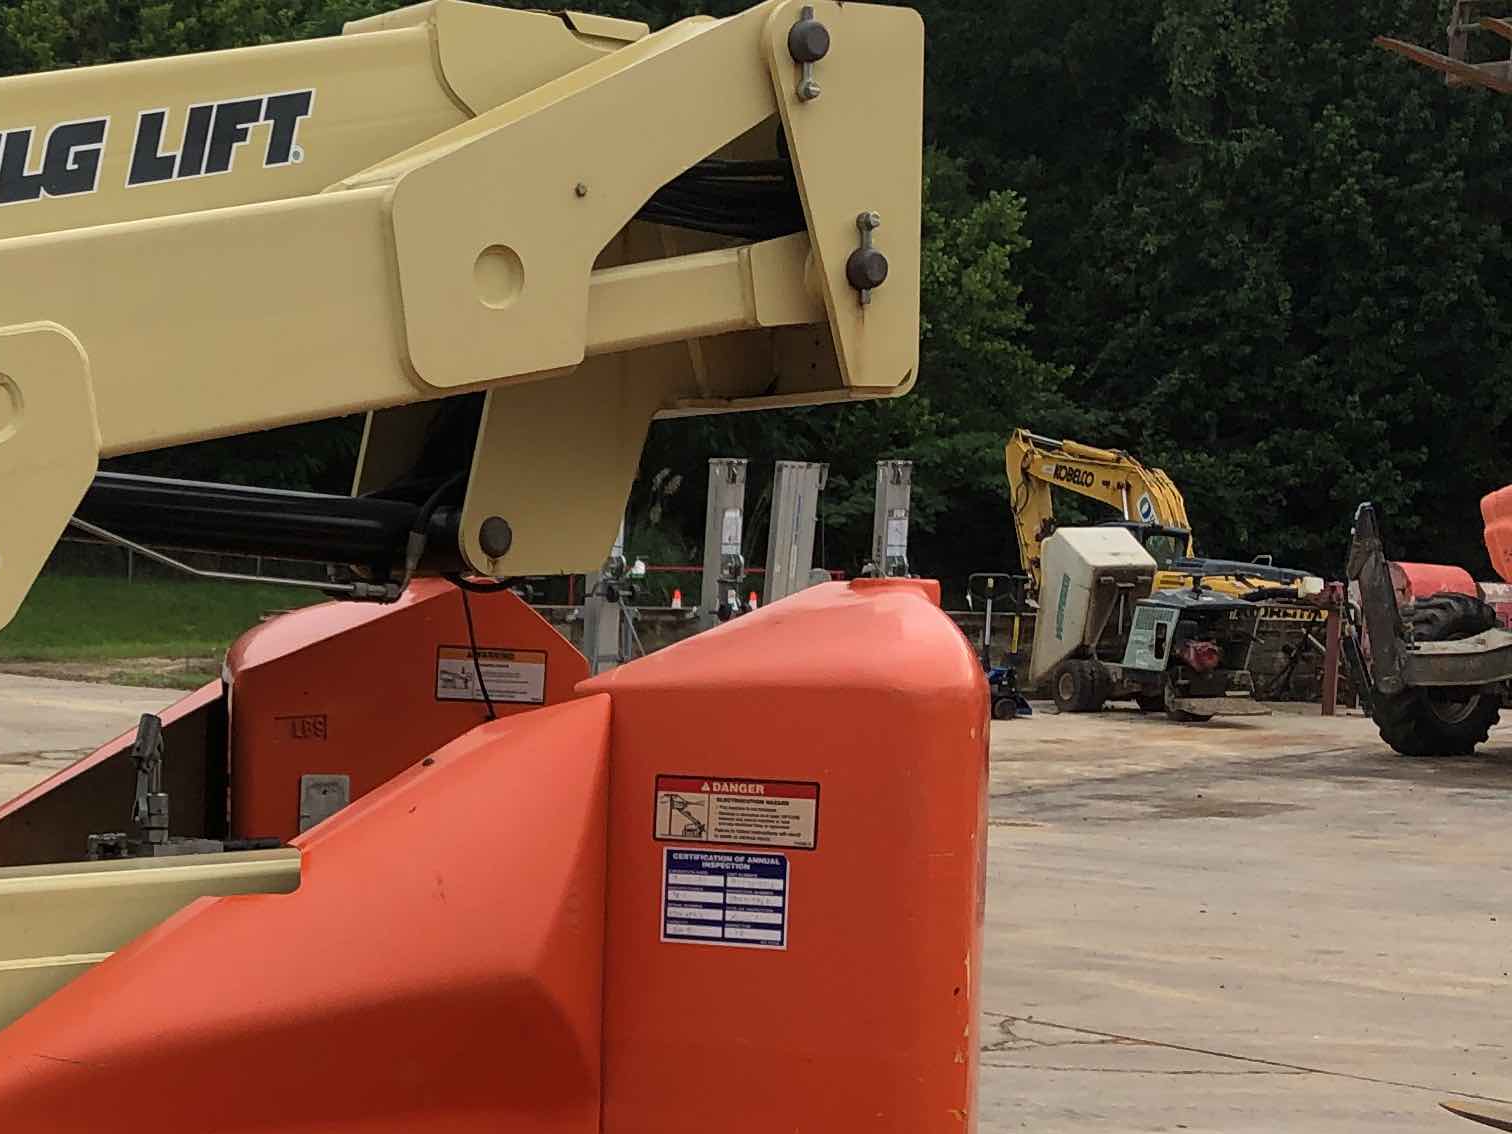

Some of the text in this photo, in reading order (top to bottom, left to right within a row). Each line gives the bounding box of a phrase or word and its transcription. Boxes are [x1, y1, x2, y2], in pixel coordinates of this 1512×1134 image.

[126, 89, 315, 188] LIFT
[1053, 463, 1095, 488] KOBELCO
[712, 782, 765, 795] DANGER
[672, 853, 733, 863] CERTIFICATION
[747, 856, 780, 865] ANNUAL
[701, 862, 751, 870] INSPECTION
